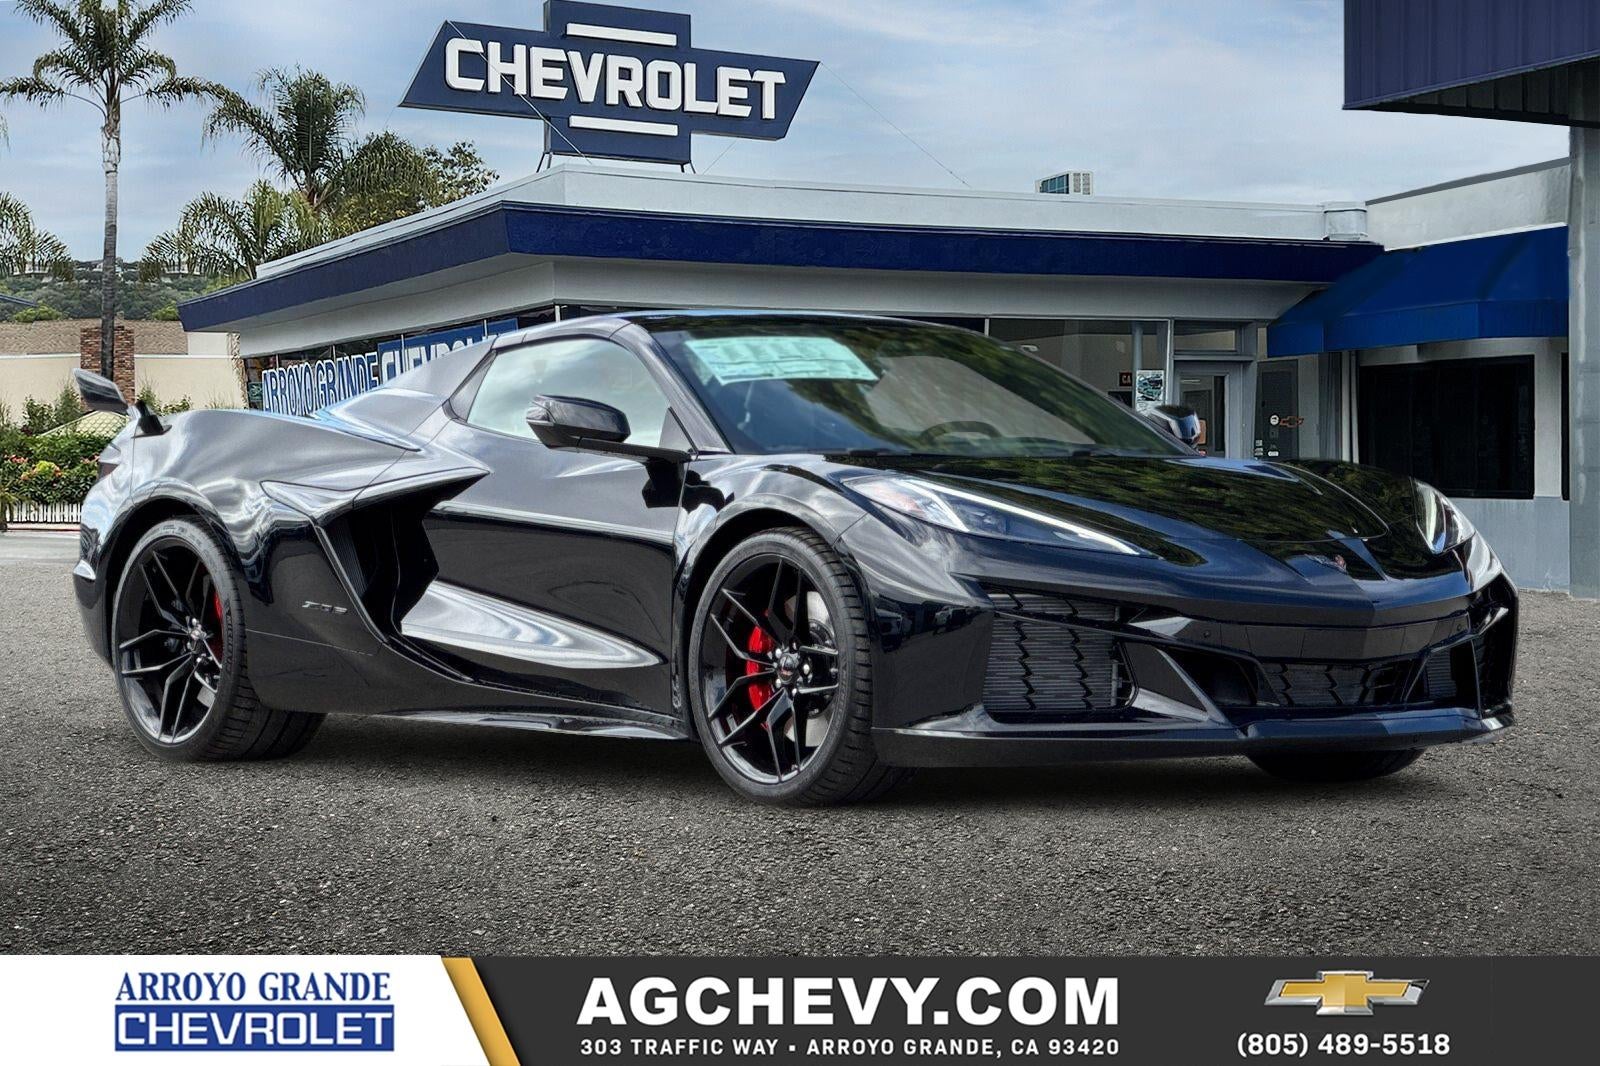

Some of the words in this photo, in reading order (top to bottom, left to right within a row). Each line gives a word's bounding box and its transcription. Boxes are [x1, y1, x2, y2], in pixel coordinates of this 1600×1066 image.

[445, 37, 786, 120] CHEVROLET
[262, 362, 315, 416] ARROYO
[314, 351, 380, 411] GRANDE
